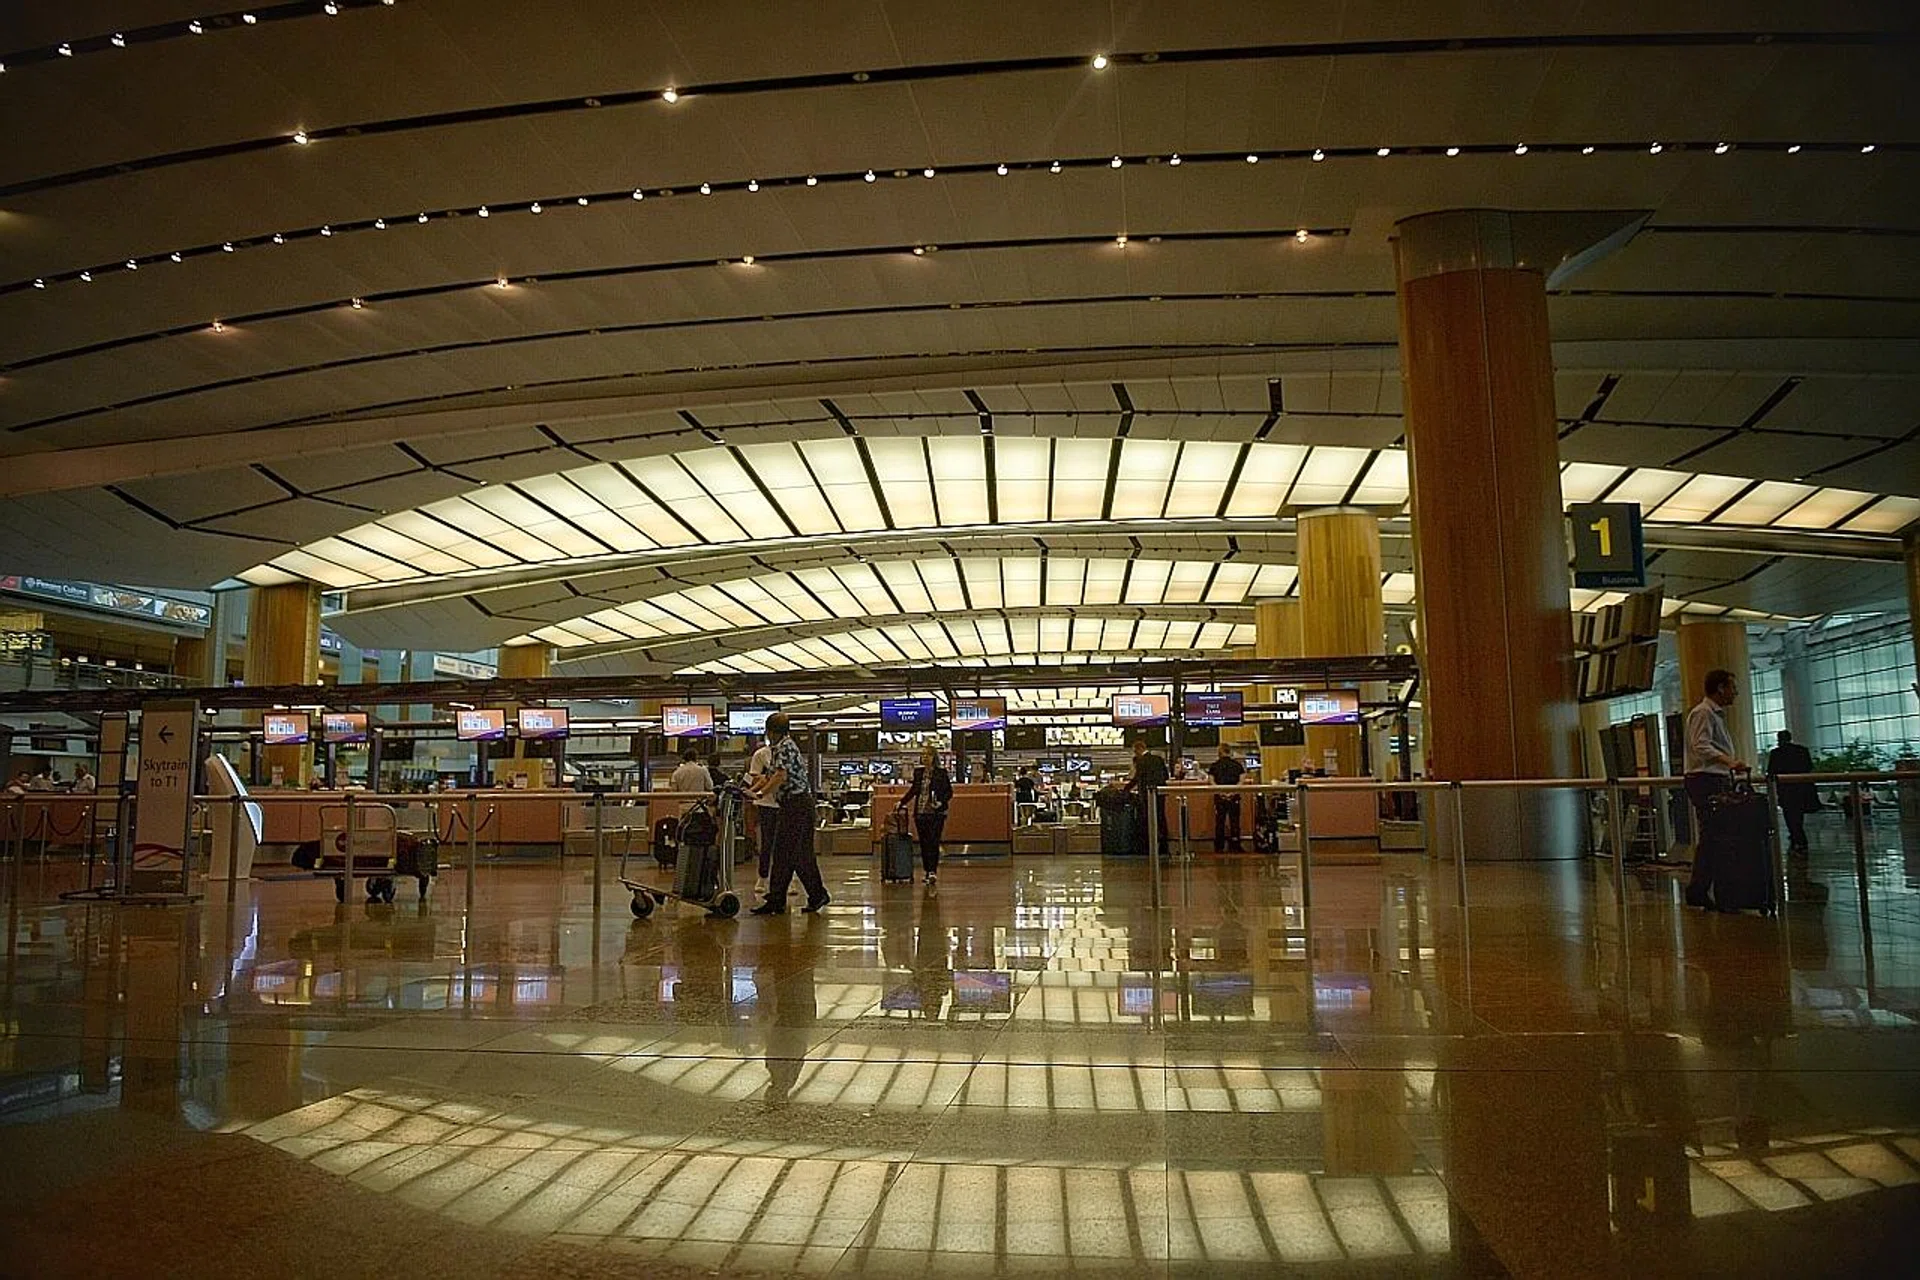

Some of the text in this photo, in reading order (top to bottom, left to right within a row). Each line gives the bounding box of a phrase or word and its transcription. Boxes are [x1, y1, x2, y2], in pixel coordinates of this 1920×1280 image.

[1590, 517, 1611, 556] 1
[144, 759, 189, 773] Skytrain
[150, 775, 178, 788] to T1
